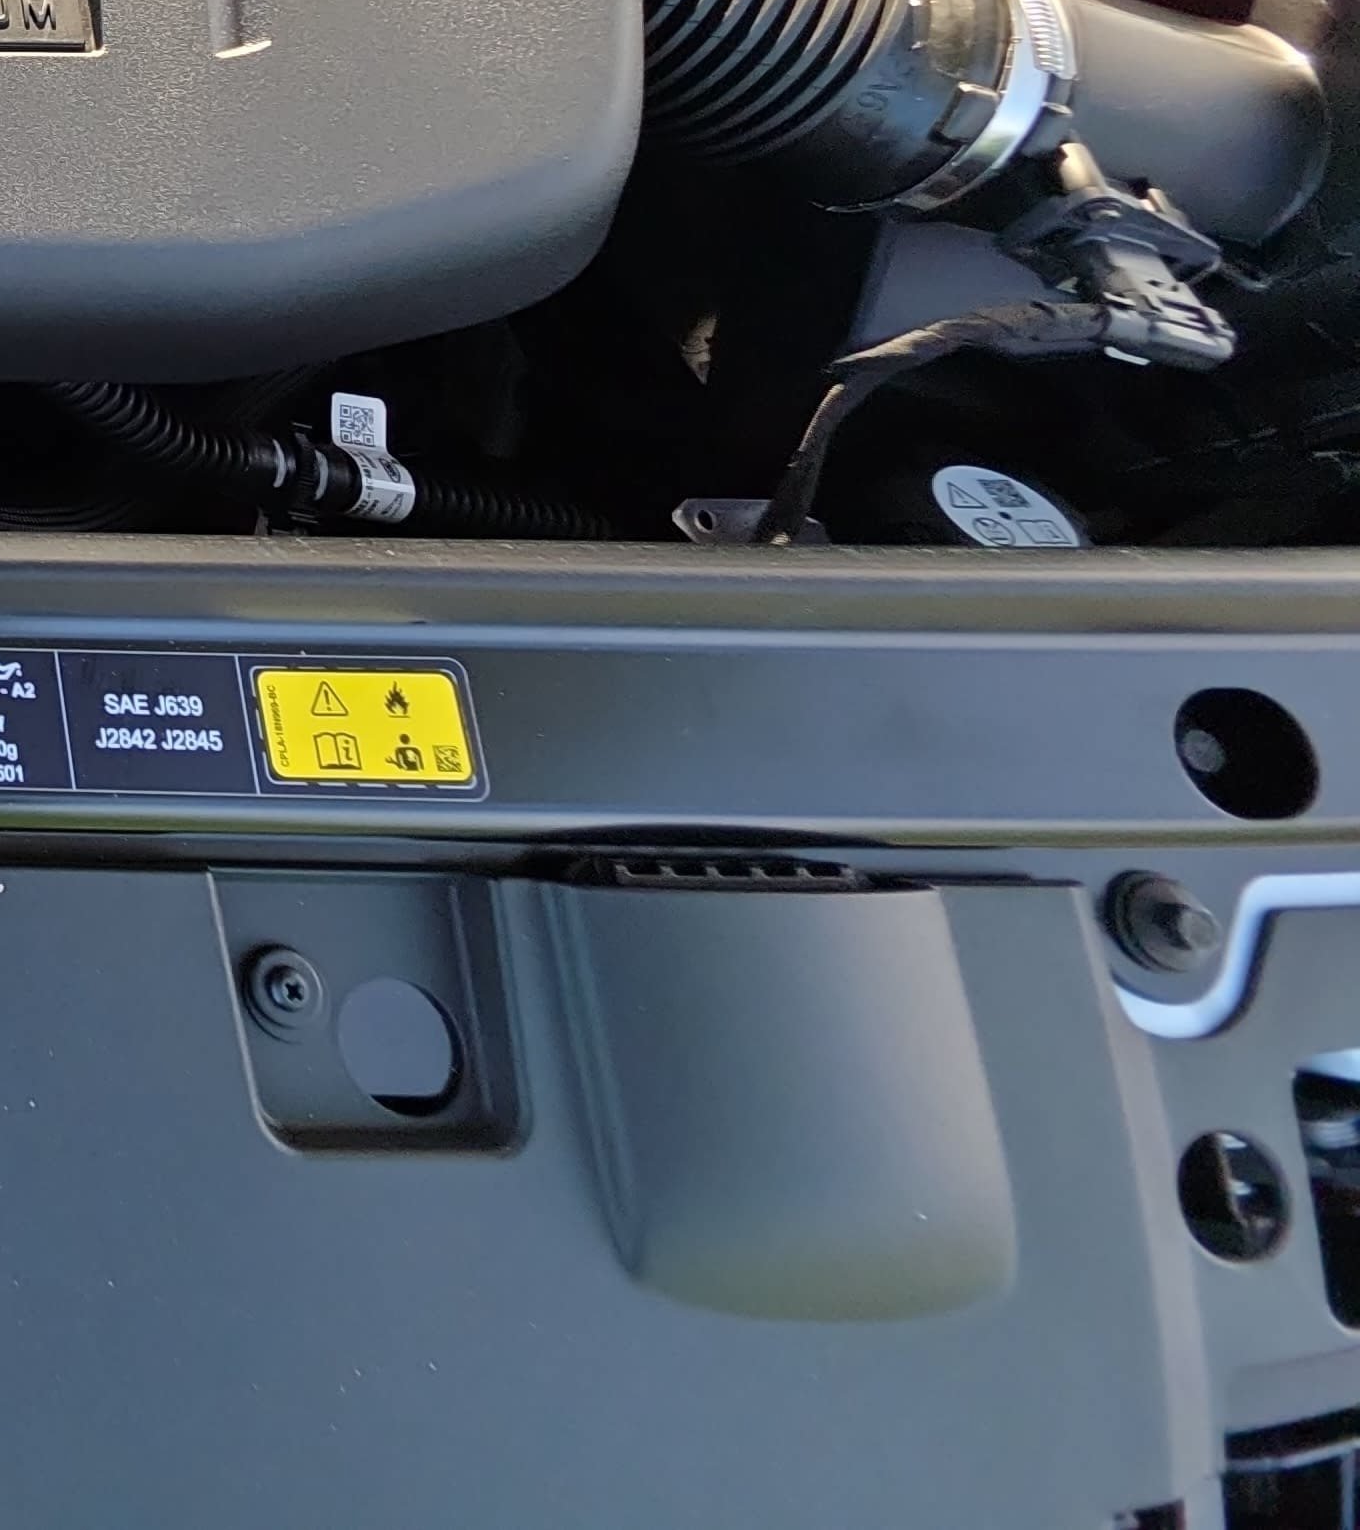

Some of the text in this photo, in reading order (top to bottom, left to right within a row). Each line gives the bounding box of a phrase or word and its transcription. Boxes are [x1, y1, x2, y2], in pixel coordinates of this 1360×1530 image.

[12, 682, 36, 698] A2
[103, 694, 203, 716] SAE J639
[95, 728, 224, 751] J2842 J2845
